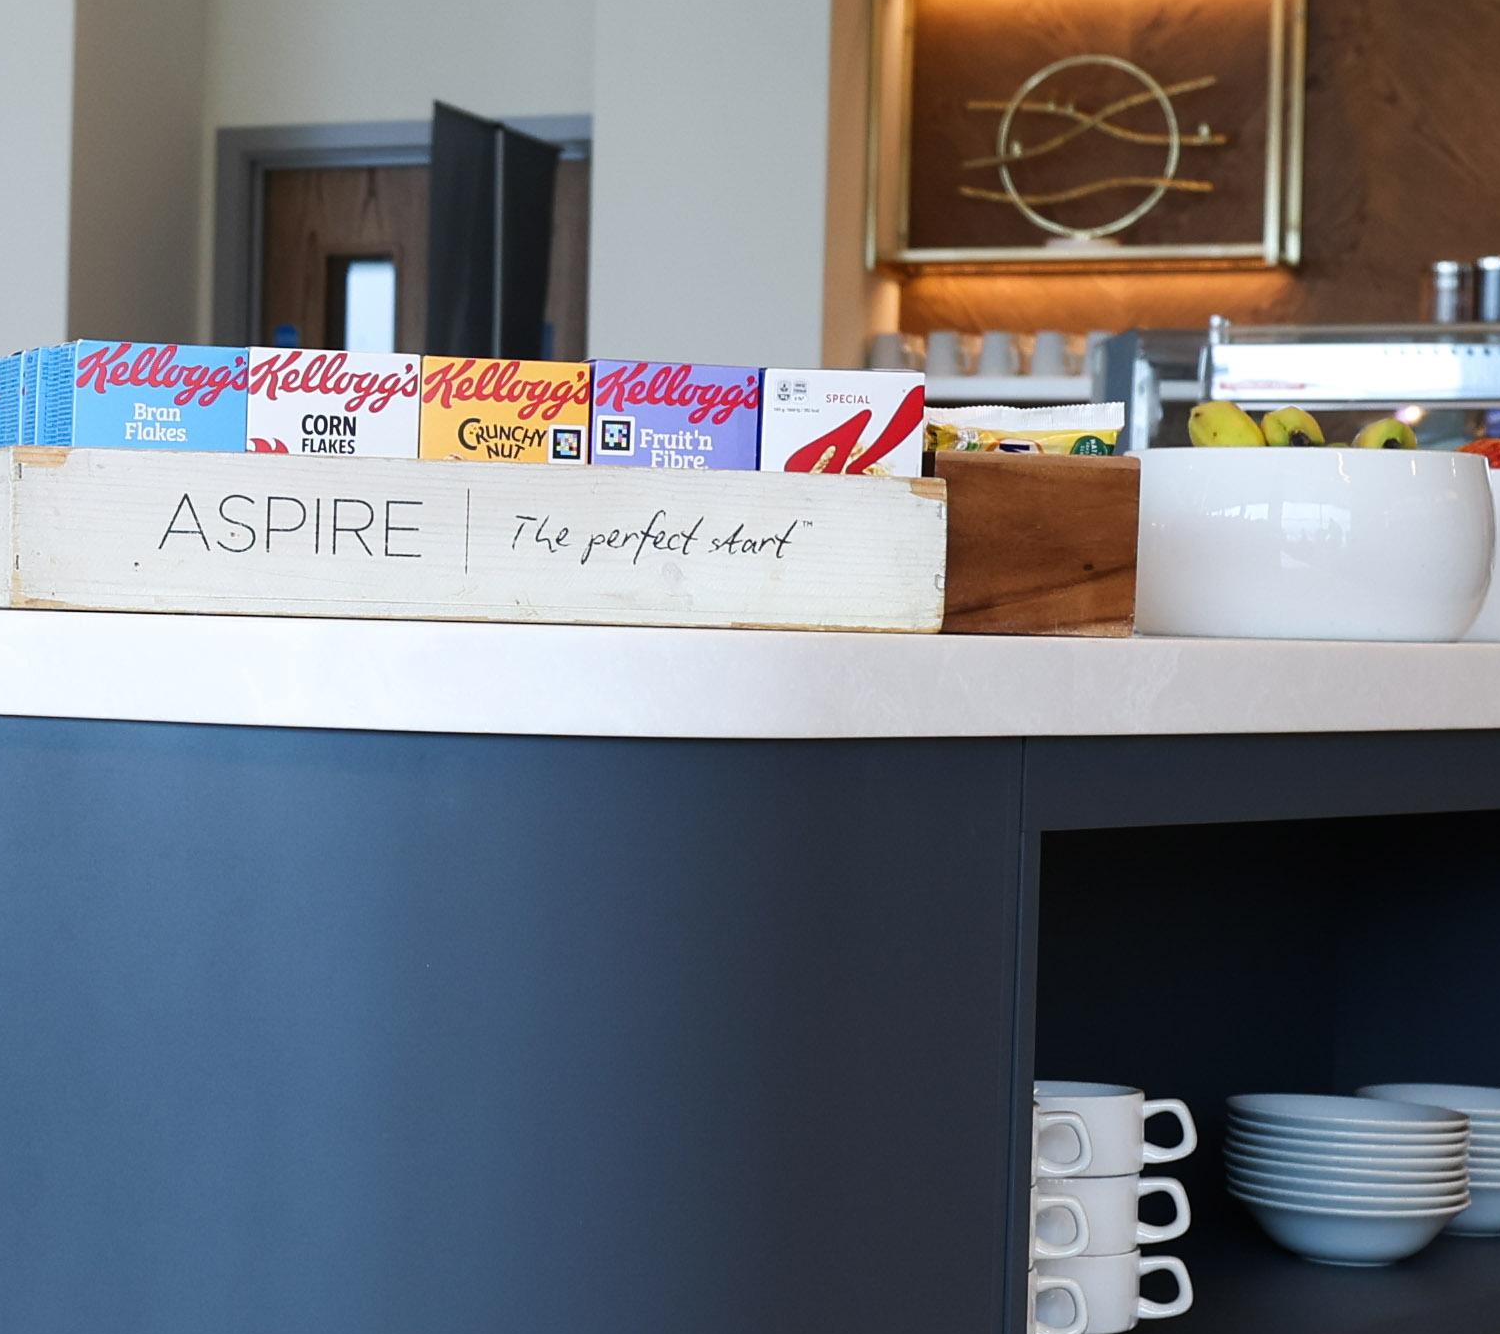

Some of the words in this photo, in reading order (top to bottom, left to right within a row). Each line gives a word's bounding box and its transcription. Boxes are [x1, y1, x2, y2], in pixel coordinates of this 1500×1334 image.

[76, 343, 248, 407] Kellogg's
[248, 351, 419, 413] Kellogg's
[422, 359, 590, 420] Kellogg's
[595, 362, 760, 425] Kellogg's
[826, 394, 871, 405] SPECIAL
[133, 403, 181, 422] Bran
[125, 422, 187, 442] Flakes
[301, 414, 356, 437] CORN
[458, 418, 548, 451] CRUNCHY
[302, 438, 356, 455] FLAKES
[486, 443, 526, 459] NUT
[640, 428, 713, 451] Fruit'n
[651, 450, 706, 469] Fibre
[158, 493, 424, 558] ASPIRE
[512, 514, 570, 553] The
[581, 509, 704, 565] perfect
